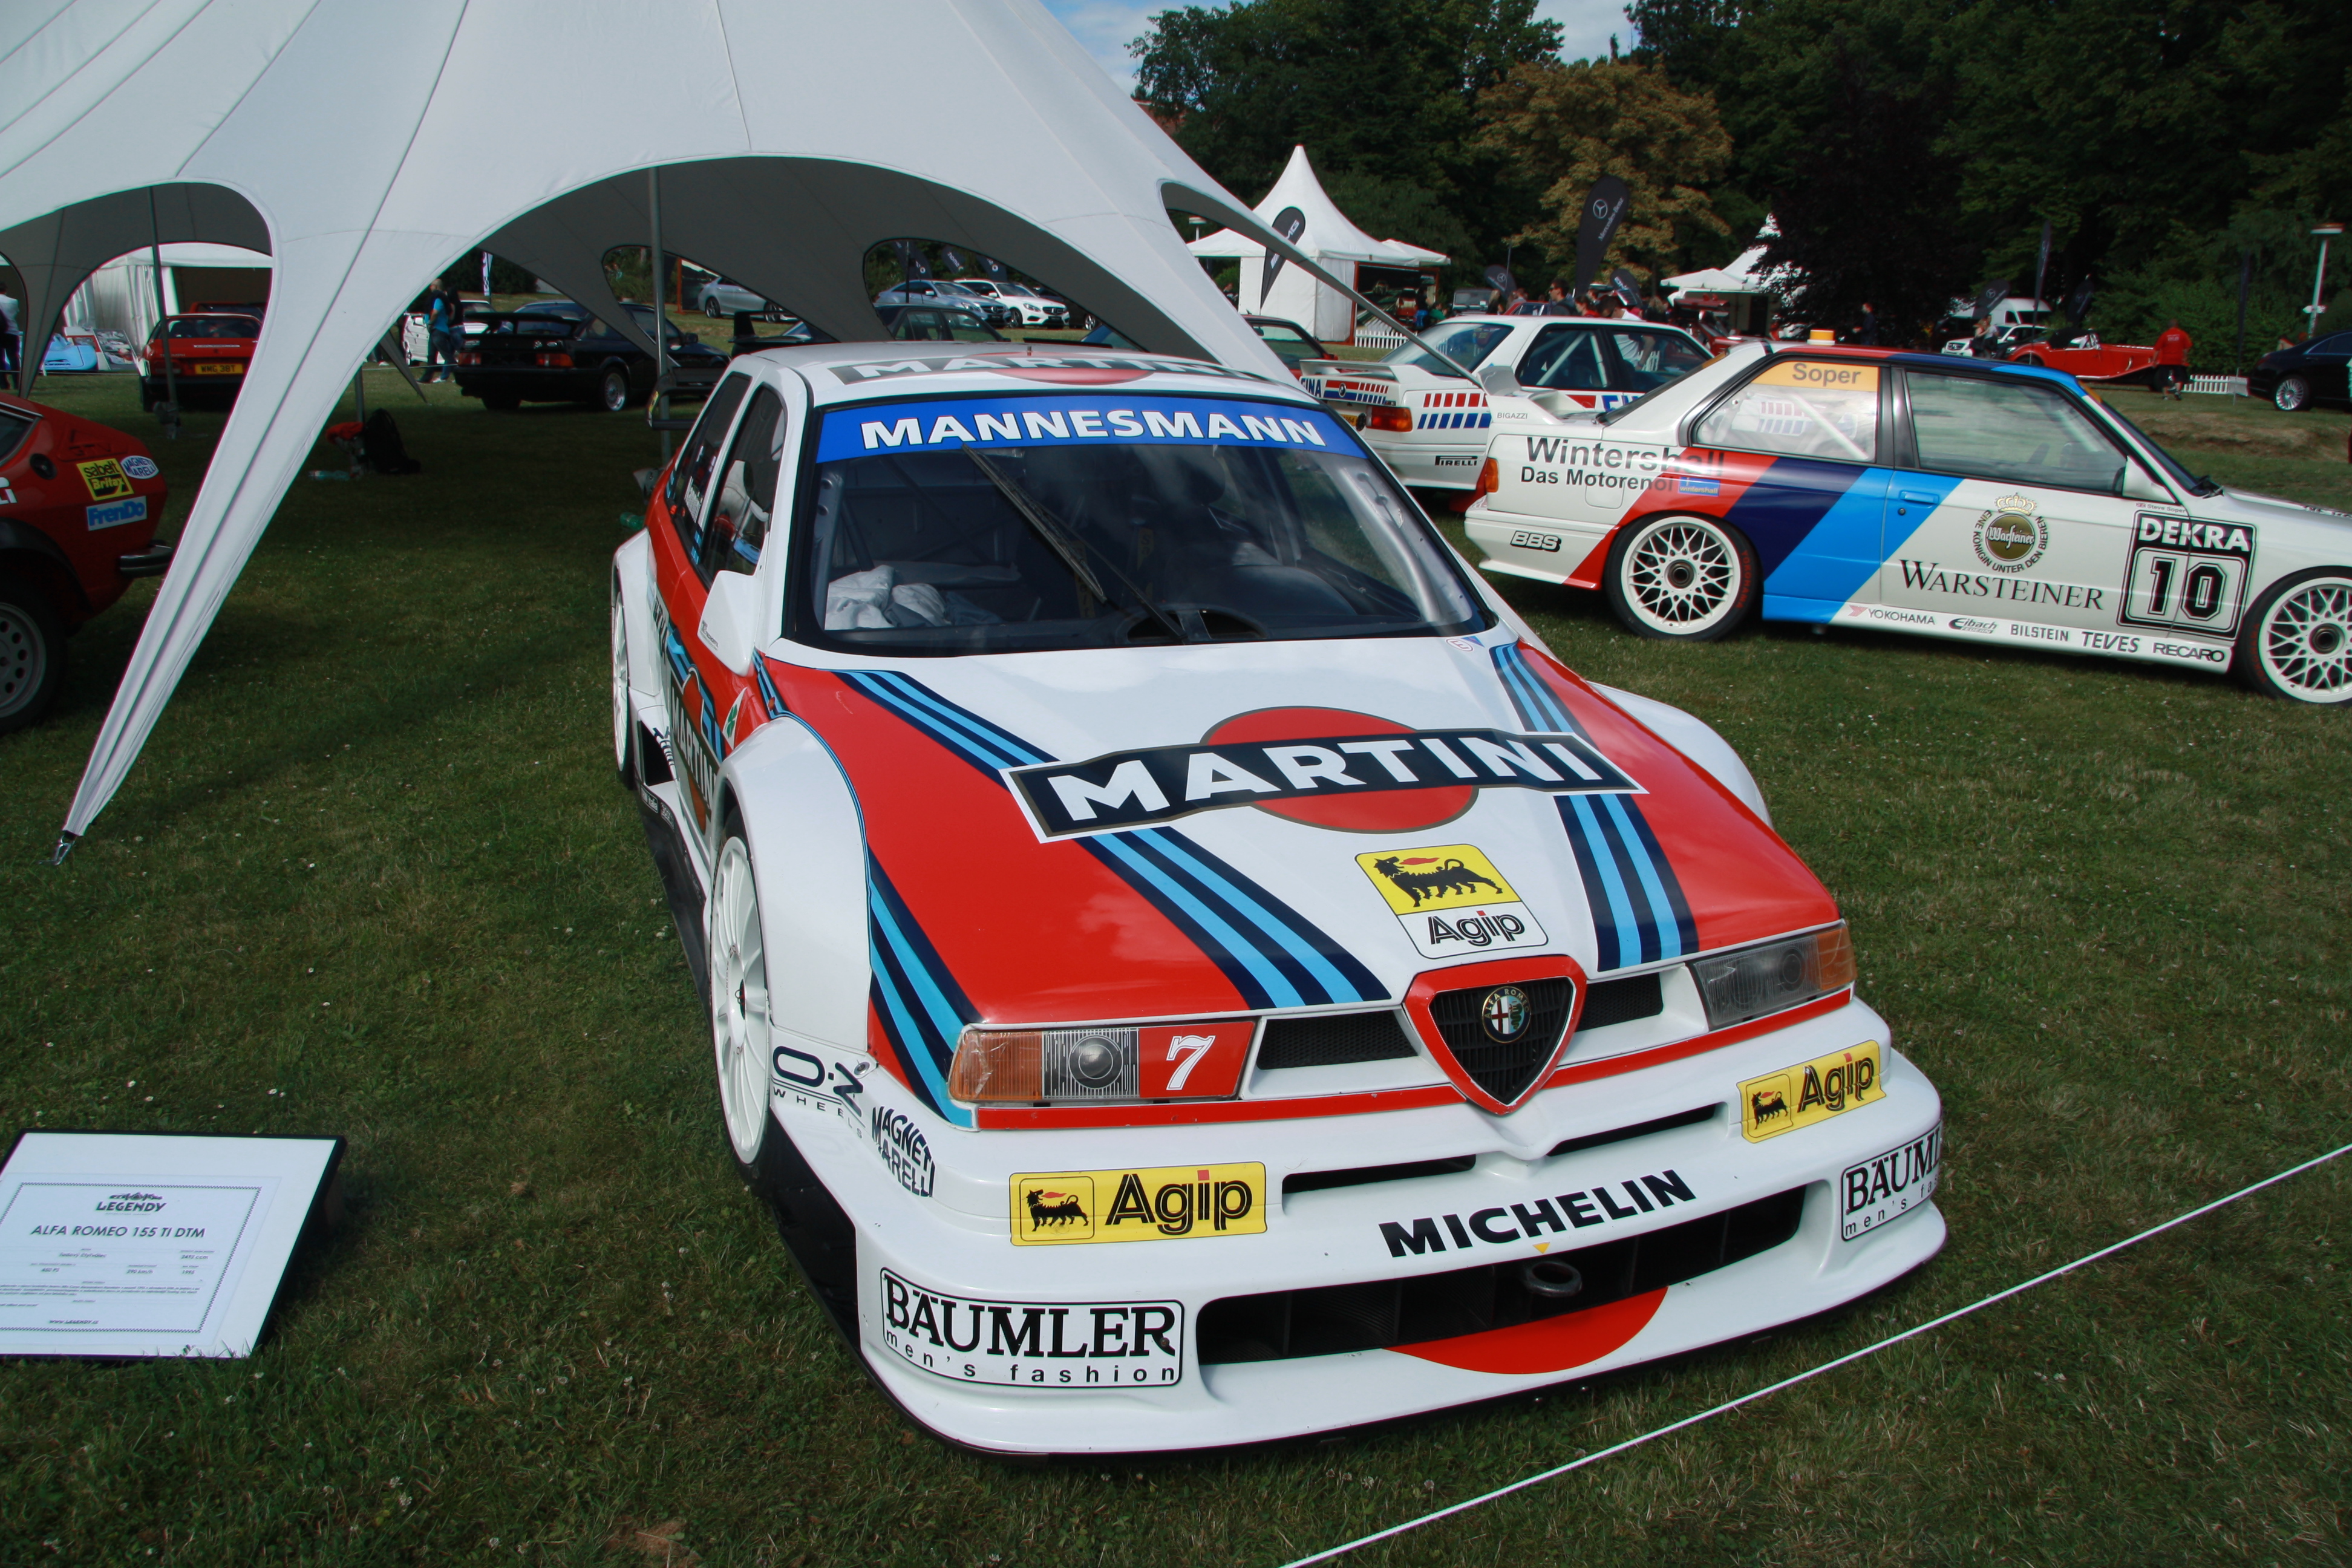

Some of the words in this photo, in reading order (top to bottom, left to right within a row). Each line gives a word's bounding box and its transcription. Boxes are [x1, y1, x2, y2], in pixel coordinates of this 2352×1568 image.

[1792, 362, 1861, 387] Soper
[861, 410, 1327, 449] MANNESMANN
[1435, 456, 1478, 466] PIRELLI
[1526, 436, 1725, 477] Wintershall
[84, 461, 120, 478] sabelt
[1521, 466, 1558, 484] Das
[91, 477, 125, 491] Britax
[89, 501, 145, 526] FrenDo
[1975, 509, 1993, 529] EINE
[1511, 531, 1561, 552] BBS
[2035, 515, 2048, 550] BIEREN
[2138, 517, 2250, 552] DEKRA
[1973, 531, 1993, 567] KÖNIGIN
[2025, 550, 2043, 568] DEN
[1992, 563, 2025, 573] UNTER
[1898, 559, 2103, 610] WARSTEINER
[2147, 557, 2227, 621] 10
[1869, 609, 1936, 625] YOKOHAMA
[1949, 618, 1998, 630] Eibach
[2010, 624, 2069, 642] BILSTEIN
[2082, 631, 2140, 653] TEVES
[2152, 642, 2225, 663] RECARO
[2250, 623, 2268, 684] YOKOHAMA
[1047, 737, 1603, 822] MARTINI
[1427, 909, 1525, 946] Agip
[1484, 993, 1500, 1019] ALFA
[1504, 988, 1529, 1013] ROMEO
[1166, 1034, 1216, 1091] 7
[1797, 1052, 1874, 1111] Agip
[773, 1086, 863, 1139] WHEELS
[96, 1201, 168, 1212] LEGENDY
[1105, 1169, 1253, 1235] Agip
[1379, 1169, 1697, 1258] MICHELIN
[31, 1225, 67, 1235] ALFA
[71, 1226, 128, 1236] ROMEO
[132, 1227, 158, 1237] 155
[160, 1227, 173, 1237] TI
[174, 1227, 206, 1238] DTM
[884, 1273, 1175, 1357] BÄUMLER
[1010, 1364, 1175, 1383] fashion
